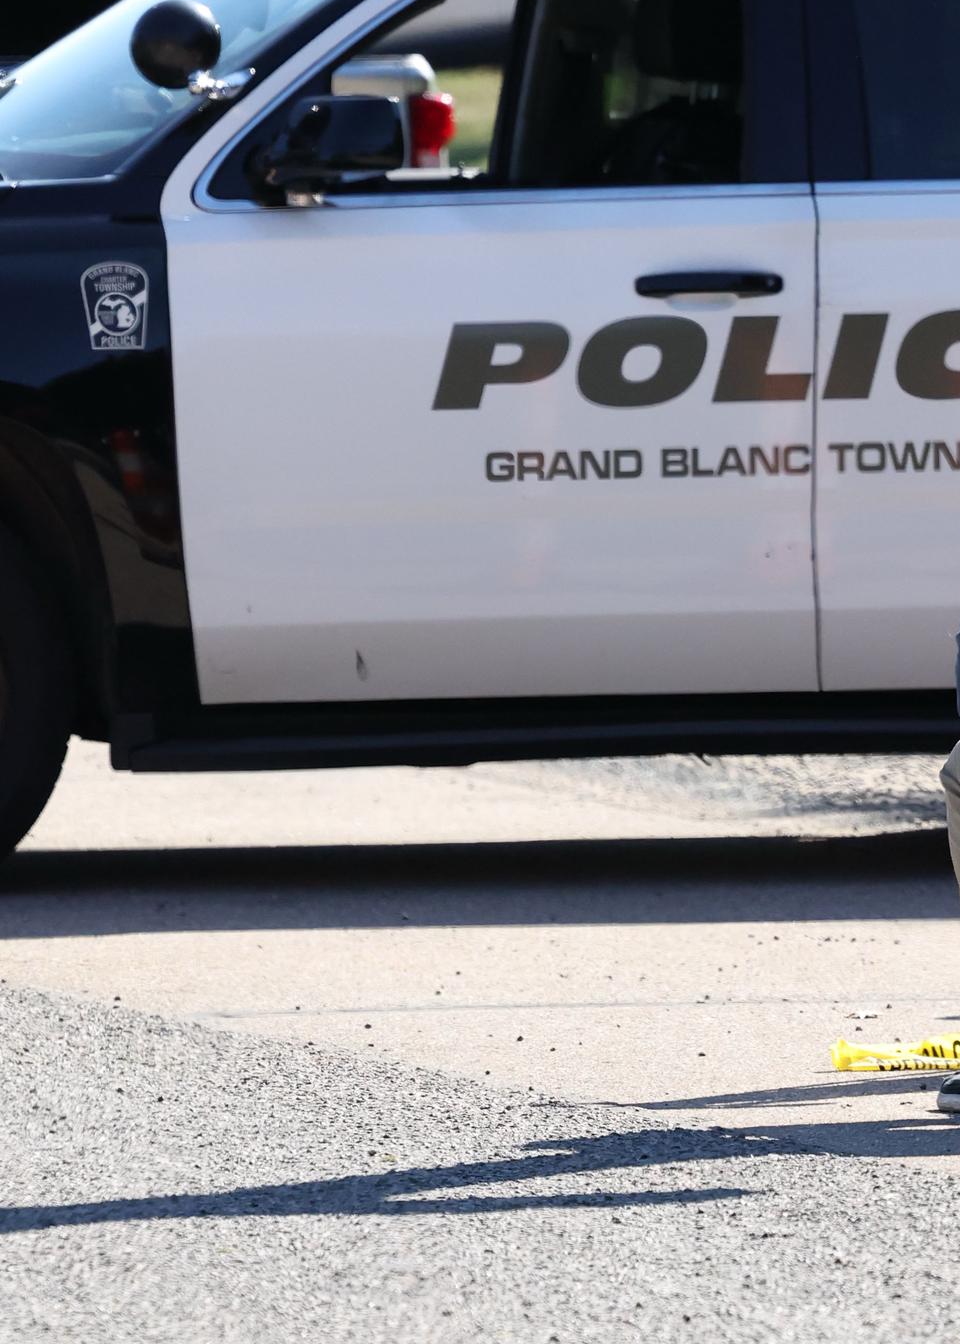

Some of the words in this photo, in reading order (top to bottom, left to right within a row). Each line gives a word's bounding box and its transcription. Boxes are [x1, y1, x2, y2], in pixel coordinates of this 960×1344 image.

[94, 282, 136, 292] TOWNSHIP
[101, 336, 137, 347] POLICE
[486, 449, 643, 482] GRAND
[661, 444, 812, 478] BLANC
